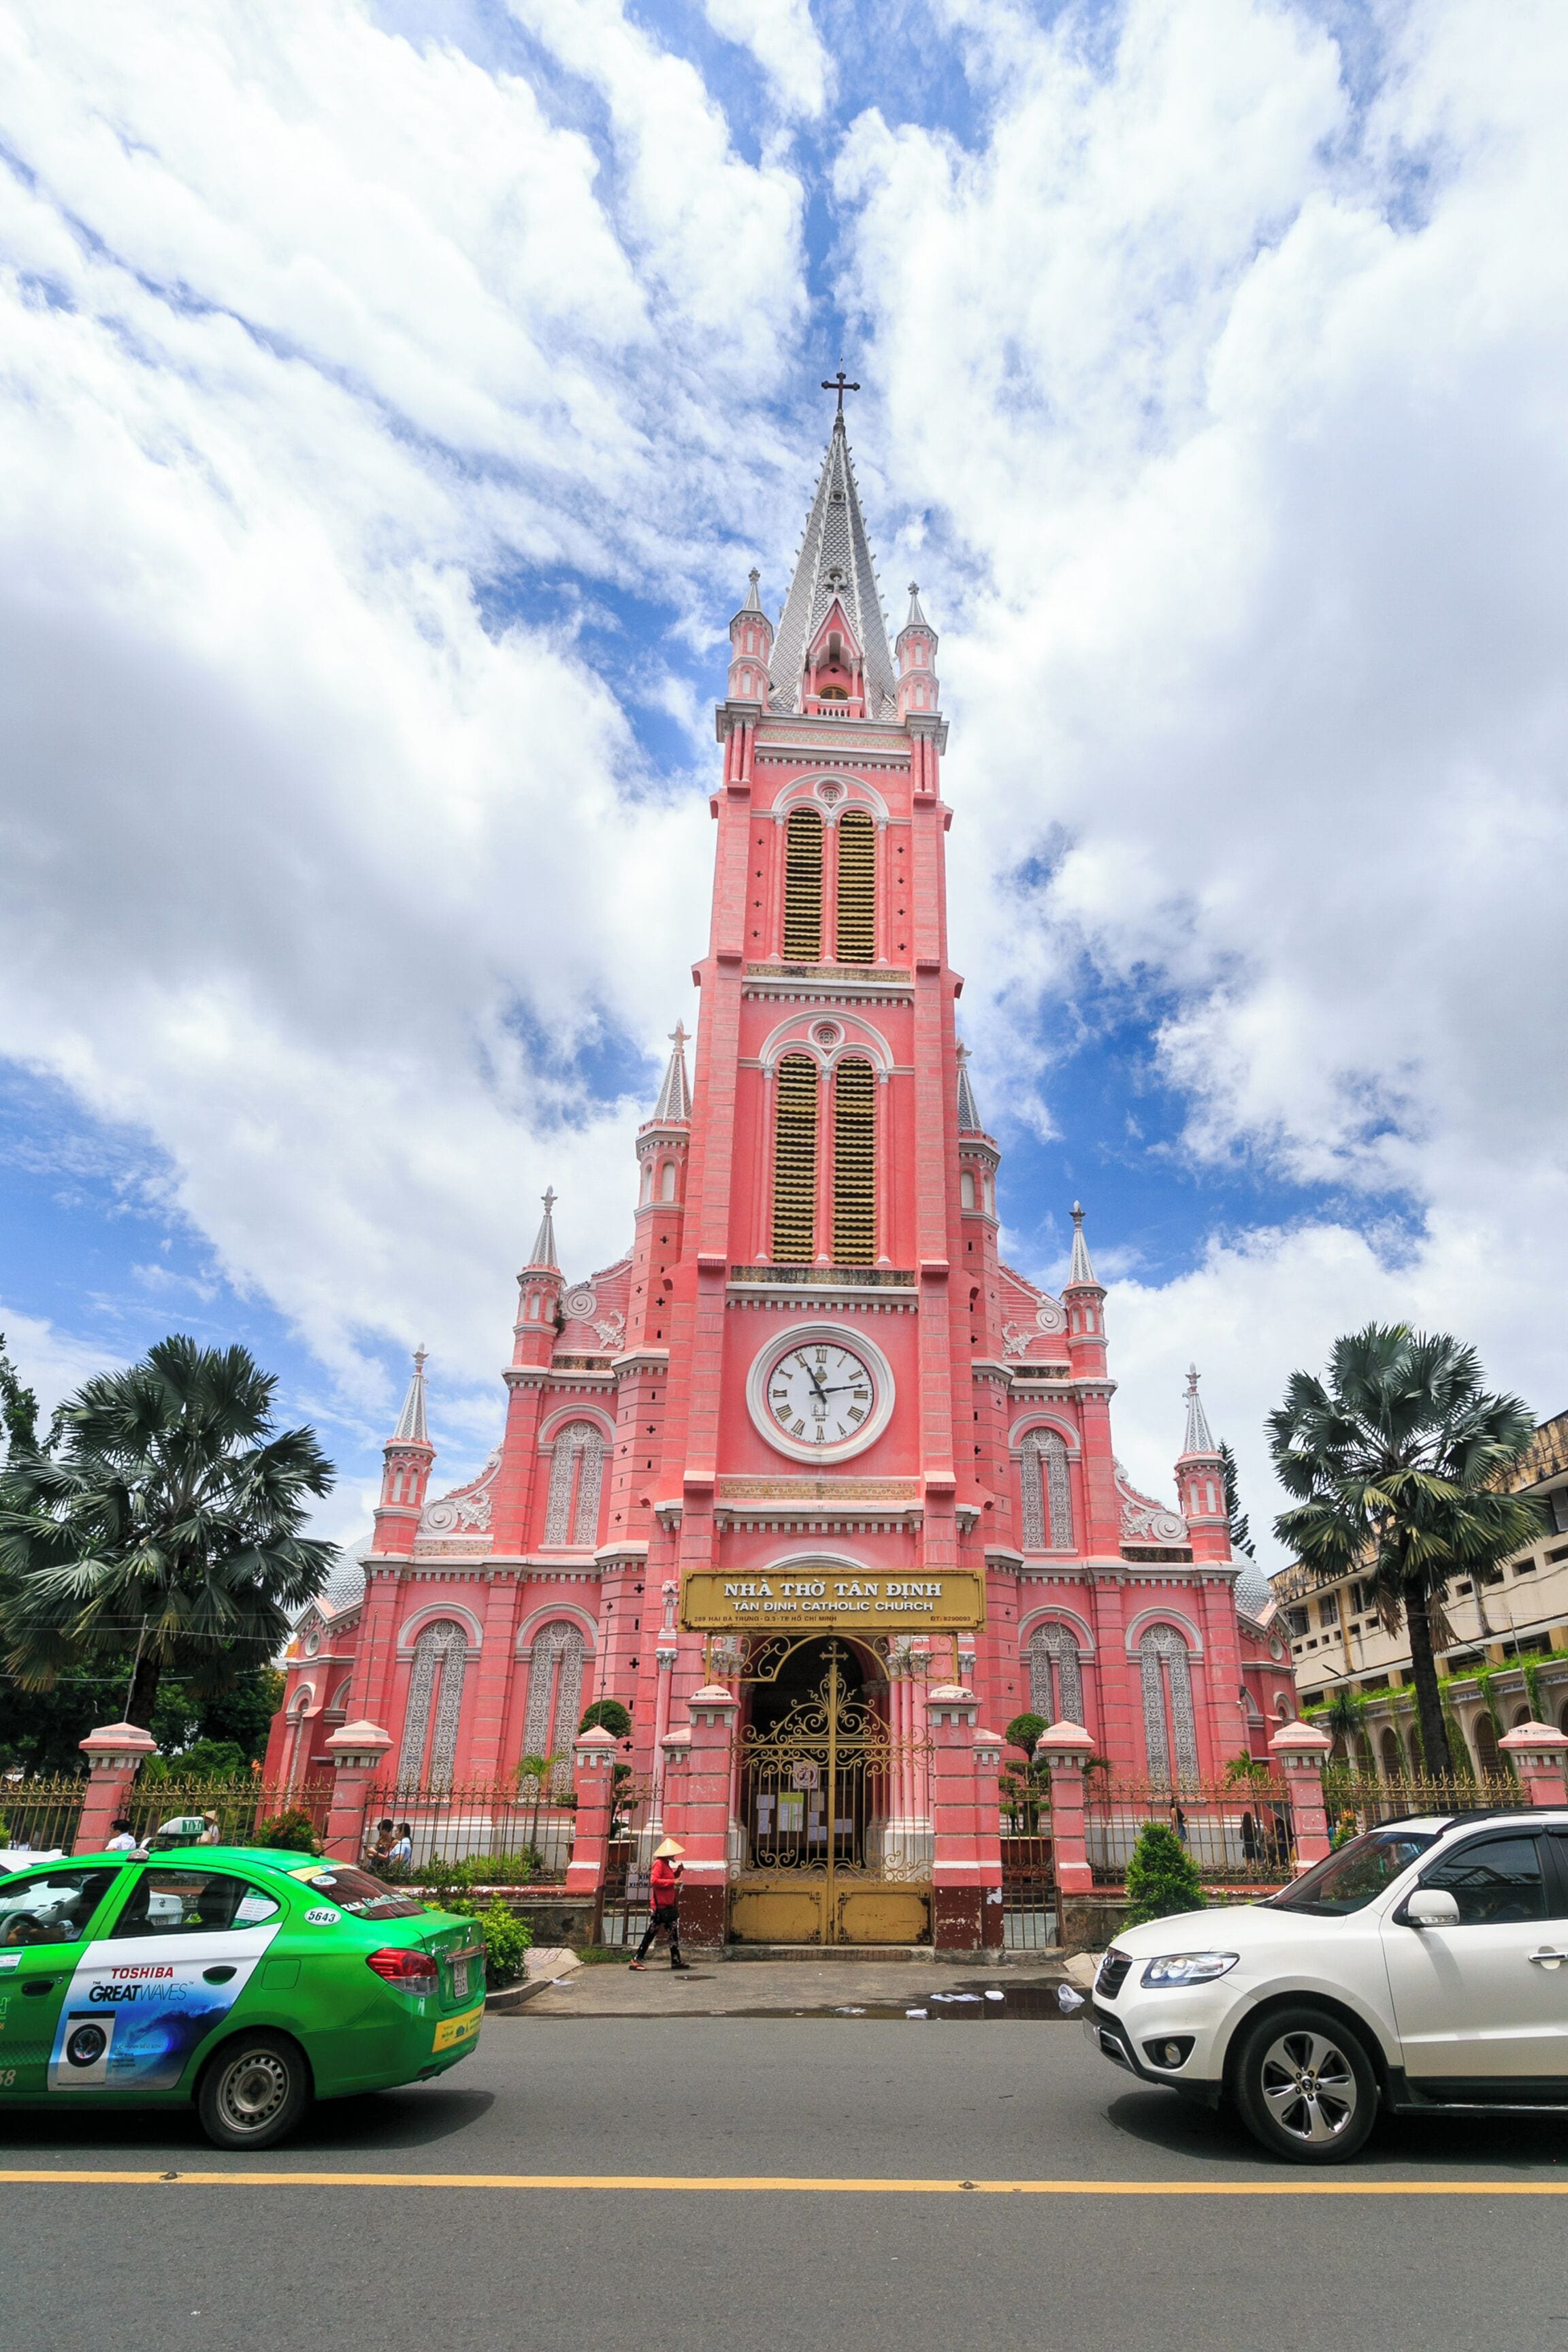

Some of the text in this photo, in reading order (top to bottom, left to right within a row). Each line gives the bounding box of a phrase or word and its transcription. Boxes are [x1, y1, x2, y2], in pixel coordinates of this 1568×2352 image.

[724, 1579, 942, 1599] NHÀ THỜ TÂN ĐỊNH
[732, 1600, 933, 1613] TÂN ĐỊNH CATHOLIC CHURCH
[308, 1910, 336, 1923] 5643
[112, 1967, 174, 1979] TOSHIBA
